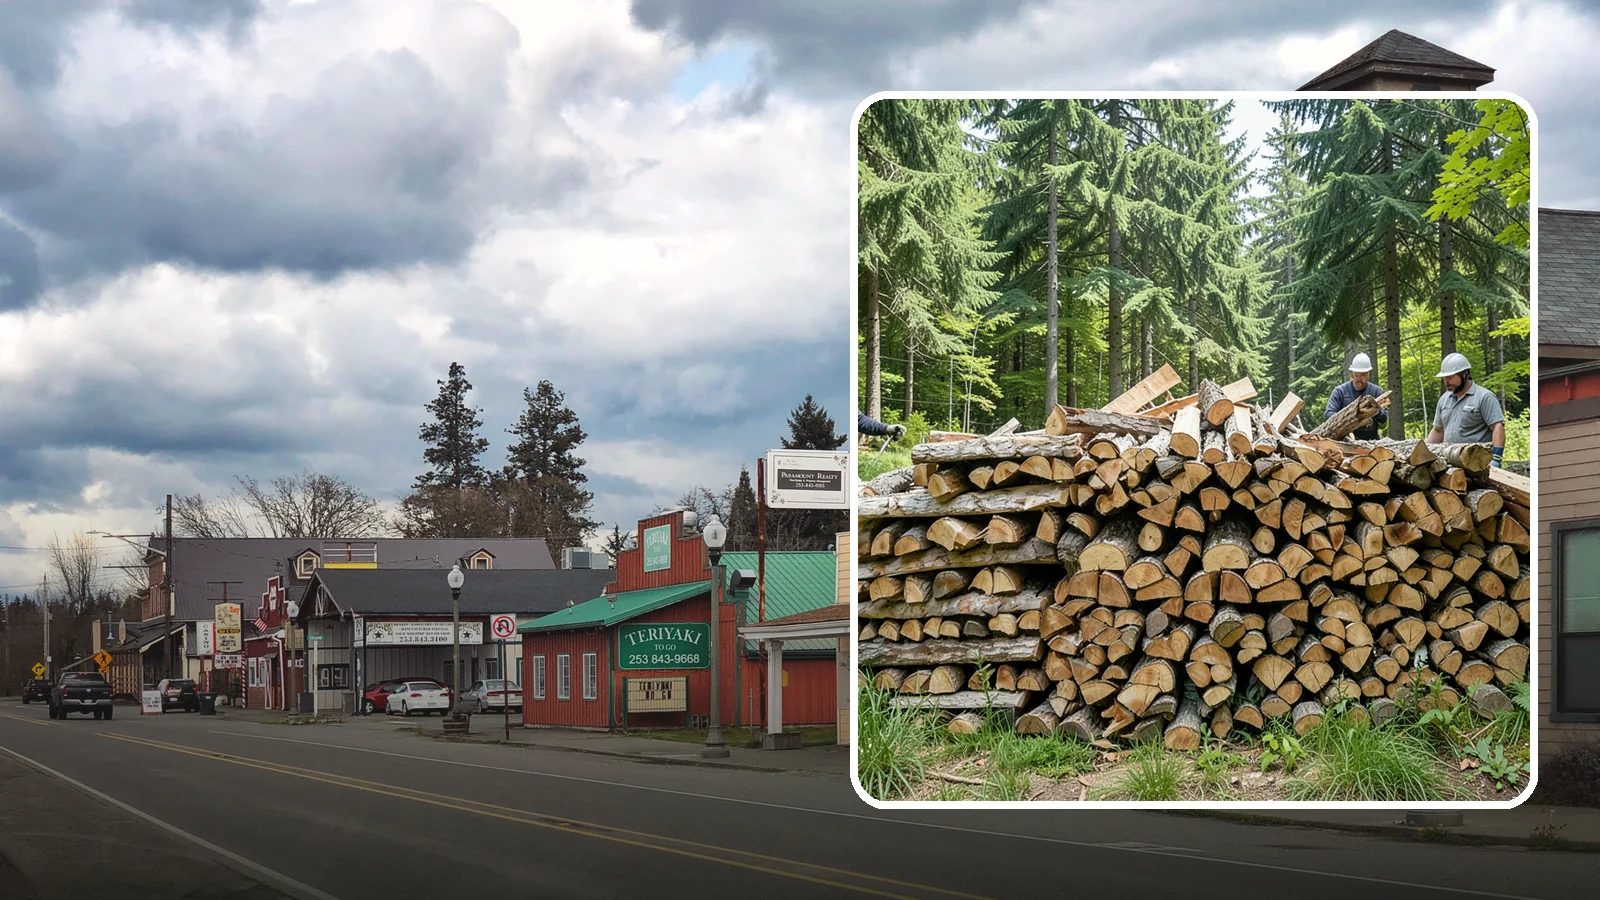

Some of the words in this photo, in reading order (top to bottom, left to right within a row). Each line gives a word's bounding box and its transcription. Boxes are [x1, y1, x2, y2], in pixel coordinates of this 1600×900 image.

[781, 471, 815, 479] PARAMOUNT
[817, 472, 839, 480] REALTY
[625, 627, 702, 646] TERIYAKI
[629, 654, 649, 664] 253
[651, 653, 700, 664] 843-9668
[639, 681, 673, 690] TERIYAKI
